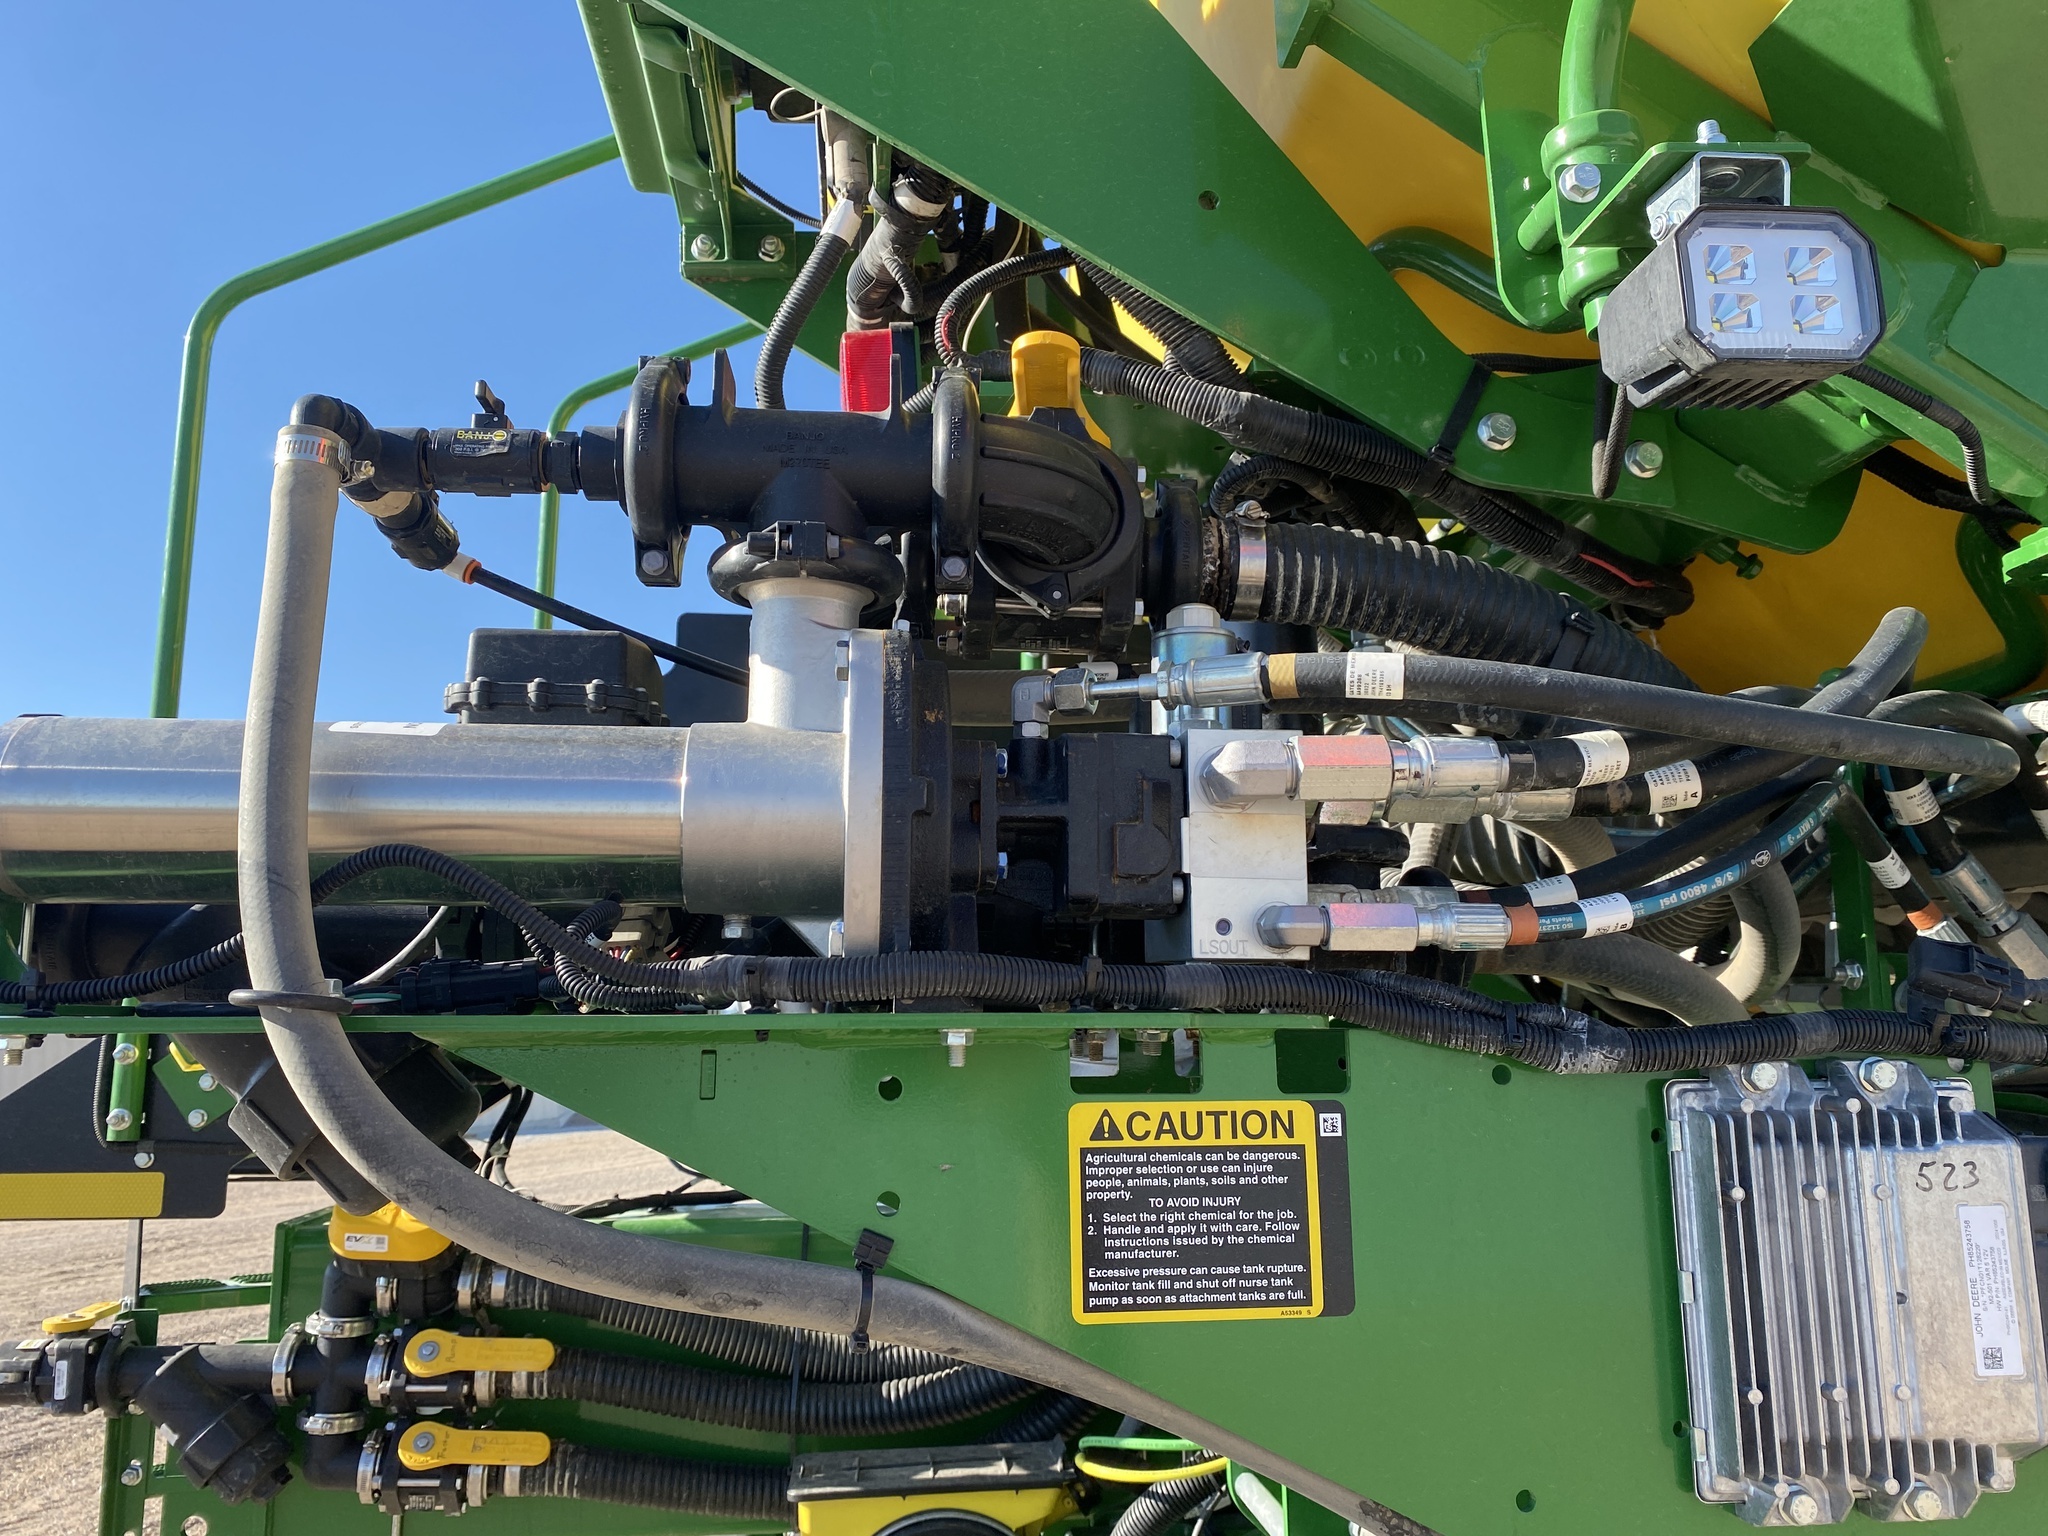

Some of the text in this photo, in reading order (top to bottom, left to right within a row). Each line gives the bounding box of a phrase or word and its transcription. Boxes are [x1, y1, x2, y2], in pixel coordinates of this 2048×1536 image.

[786, 431, 825, 441] BANJO
[1659, 871, 1735, 910] 3/8" 4800 psi
[1561, 922, 1574, 930] ISO
[1199, 939, 1249, 956] LSOUT
[1126, 1110, 1295, 1140] CAUTION
[1085, 1151, 1300, 1164] Agricultural chemicals can be dangerous.
[1086, 1165, 1132, 1176] Improper
[1136, 1164, 1183, 1174] selection
[1200, 1165, 1218, 1173] use
[1222, 1164, 1241, 1172] can
[1244, 1163, 1273, 1174] injure
[1916, 1160, 1981, 1193] 523
[1086, 1174, 1288, 1189] people, animals, plants, soils and other
[1086, 1189, 1133, 1202] property.
[1149, 1197, 1241, 1208] TO AVOID INJURY
[1088, 1209, 1297, 1223] 1. Select the right chemical for the job.
[1088, 1221, 1300, 1236] 2. Handle and apply it with care. Follow
[1104, 1233, 1295, 1247] instructions issued by the chemical
[1104, 1249, 1180, 1259] manufacturer.
[1089, 1264, 1306, 1278] Excessive pressure can cause tank rupture.
[1089, 1277, 1293, 1292] Monitor tank fill and shut off nurse tank
[1089, 1290, 1306, 1307] pump as soon as attachment tanks are full.
[1970, 1277, 1981, 1308] DEERE
[1974, 1313, 1985, 1339] JOHN
